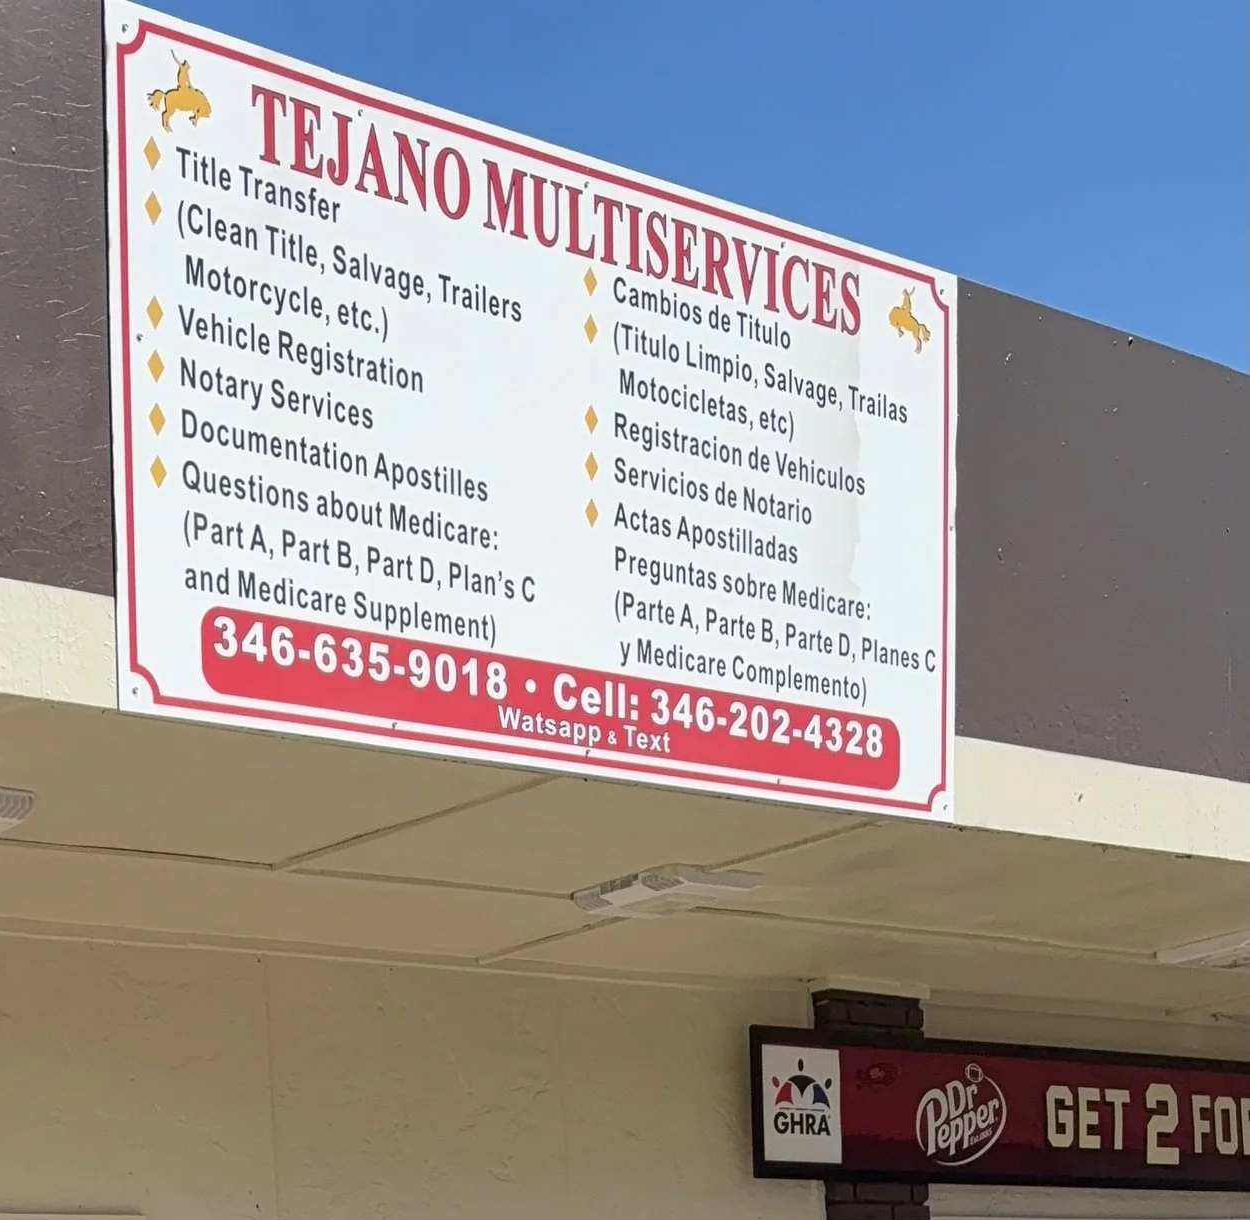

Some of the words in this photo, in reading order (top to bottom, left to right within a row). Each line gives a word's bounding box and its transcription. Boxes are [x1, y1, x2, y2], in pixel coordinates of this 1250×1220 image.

[176, 146, 231, 191] Title
[239, 165, 341, 223] Transfer
[251, 84, 471, 221] TEJANO
[482, 157, 862, 337] MULTISERVICES
[178, 200, 258, 251] (Clean
[265, 224, 325, 275] Title,
[332, 245, 431, 304] Salvage,
[438, 273, 522, 322] Trailers
[185, 254, 330, 326] Motorcycle,
[337, 301, 388, 343] etc.)
[178, 304, 270, 355] Vehicle
[278, 329, 423, 393] Registration
[613, 276, 702, 325] Cambios
[708, 304, 731, 333] de
[736, 310, 791, 350] Titulo
[180, 357, 263, 411] Notary
[271, 379, 373, 430] Services
[613, 321, 680, 363] (Titulo
[686, 341, 758, 389] Limpio,
[764, 362, 843, 412] Salvage,
[848, 384, 908, 424] Trailas
[620, 368, 754, 431] Motocicletas,
[759, 408, 794, 443] etc)
[181, 408, 368, 477] Documentation
[373, 452, 488, 502] Apostilles
[614, 411, 742, 467] Registracion
[748, 445, 770, 473] de
[775, 450, 866, 496] Vehiculos
[614, 457, 709, 502] Servicios
[715, 481, 737, 509] de
[743, 486, 812, 525] Notario
[182, 460, 309, 513] Questions
[316, 490, 383, 528] about
[390, 502, 498, 551] Medicare:
[614, 502, 672, 538] Actas
[676, 516, 798, 564] Apostilladas
[184, 510, 244, 549] (Part
[250, 524, 274, 560] A,
[282, 529, 330, 566] Part
[337, 540, 359, 576] B,
[367, 546, 413, 581] Part
[420, 556, 441, 591] D,
[449, 561, 515, 599] Plan's
[521, 576, 535, 603] C
[615, 545, 717, 590] Preguntas
[723, 572, 777, 602] sobre
[783, 580, 870, 620] Medicare:
[185, 567, 230, 595] and
[238, 570, 346, 616] Medicare
[354, 591, 496, 649] Supplement)
[615, 590, 675, 625] (Parte
[680, 603, 699, 634] A,
[706, 607, 755, 640] Parte
[761, 618, 779, 649] B,
[785, 622, 833, 655] Parte
[838, 632, 855, 663] D,
[862, 636, 920, 670] Planes
[925, 649, 936, 673] C
[212, 615, 509, 701] 346-635-9018
[553, 672, 640, 720] Cell:
[651, 687, 883, 759] 346-202-4328
[620, 641, 631, 667] y
[637, 638, 727, 677] Medicare
[732, 655, 867, 707] Complemento)
[498, 705, 601, 747] Watsapp
[607, 730, 617, 745] &
[623, 724, 671, 754] Text
[773, 1111, 831, 1136] GHRA
[916, 1088, 999, 1157] Pepper
[945, 1080, 978, 1119] Dr
[1046, 1084, 1131, 1151] GET
[1146, 1083, 1180, 1165] 2
